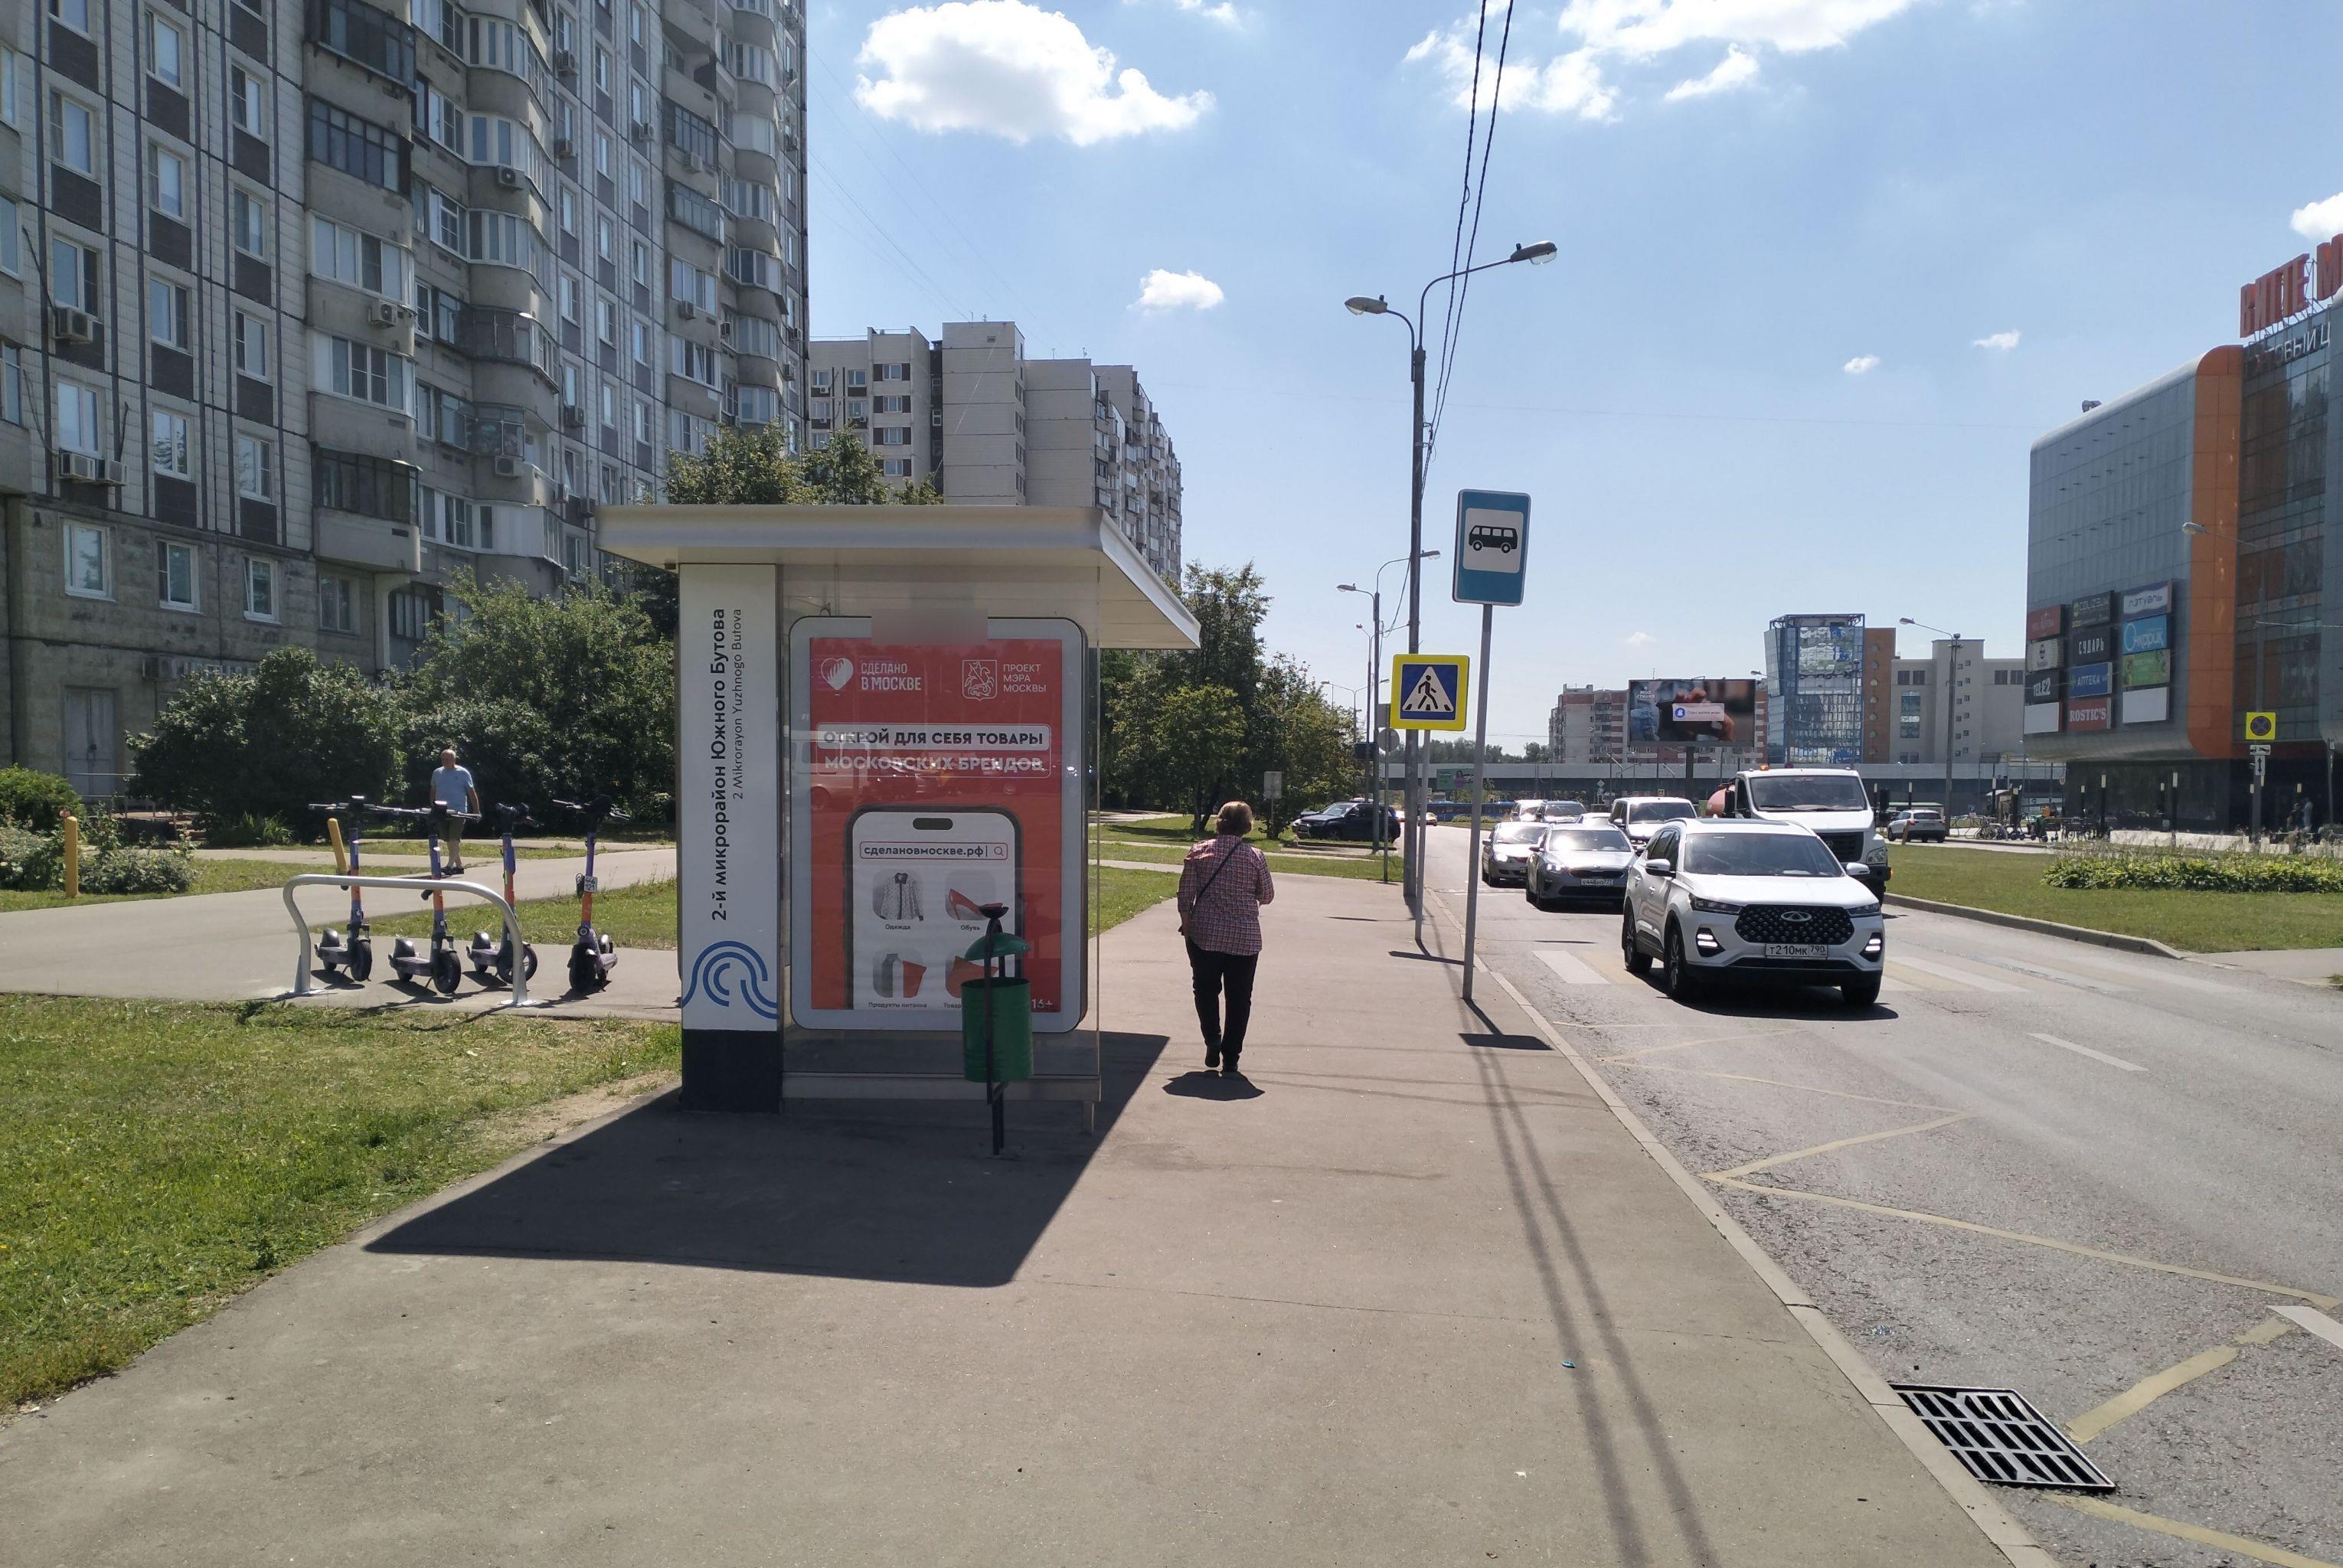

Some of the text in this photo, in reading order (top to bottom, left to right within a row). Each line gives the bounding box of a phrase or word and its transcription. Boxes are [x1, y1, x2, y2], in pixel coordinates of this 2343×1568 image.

[731, 609, 742, 650] Butova
[2078, 638, 2104, 655] СУДАРЬ
[861, 662, 908, 675] СДЕЛАНО
[1003, 663, 1041, 672] ПРОЕКТ
[732, 654, 744, 714] Yuzhnogo
[861, 677, 922, 691] В МОСКВЕ
[2033, 678, 2051, 697] TELE2
[2077, 674, 2100, 687] АПТЕКА
[1003, 684, 1047, 693] МОСКВЫ
[2069, 707, 2106, 722] ROSTIC'S
[894, 732, 926, 746] ДЛЯ
[931, 732, 972, 744] СЕБЯ
[976, 733, 1043, 745] ТОВАРЫ
[732, 718, 744, 789] Mikrorayon
[710, 609, 730, 921] 2-й микрорайон Южного Бутова
[825, 754, 1044, 773] МОСКОВСКИХ БРЕНДОВ
[864, 845, 984, 858] сделановмоскве.рф
[1031, 998, 1054, 1008] 16+
